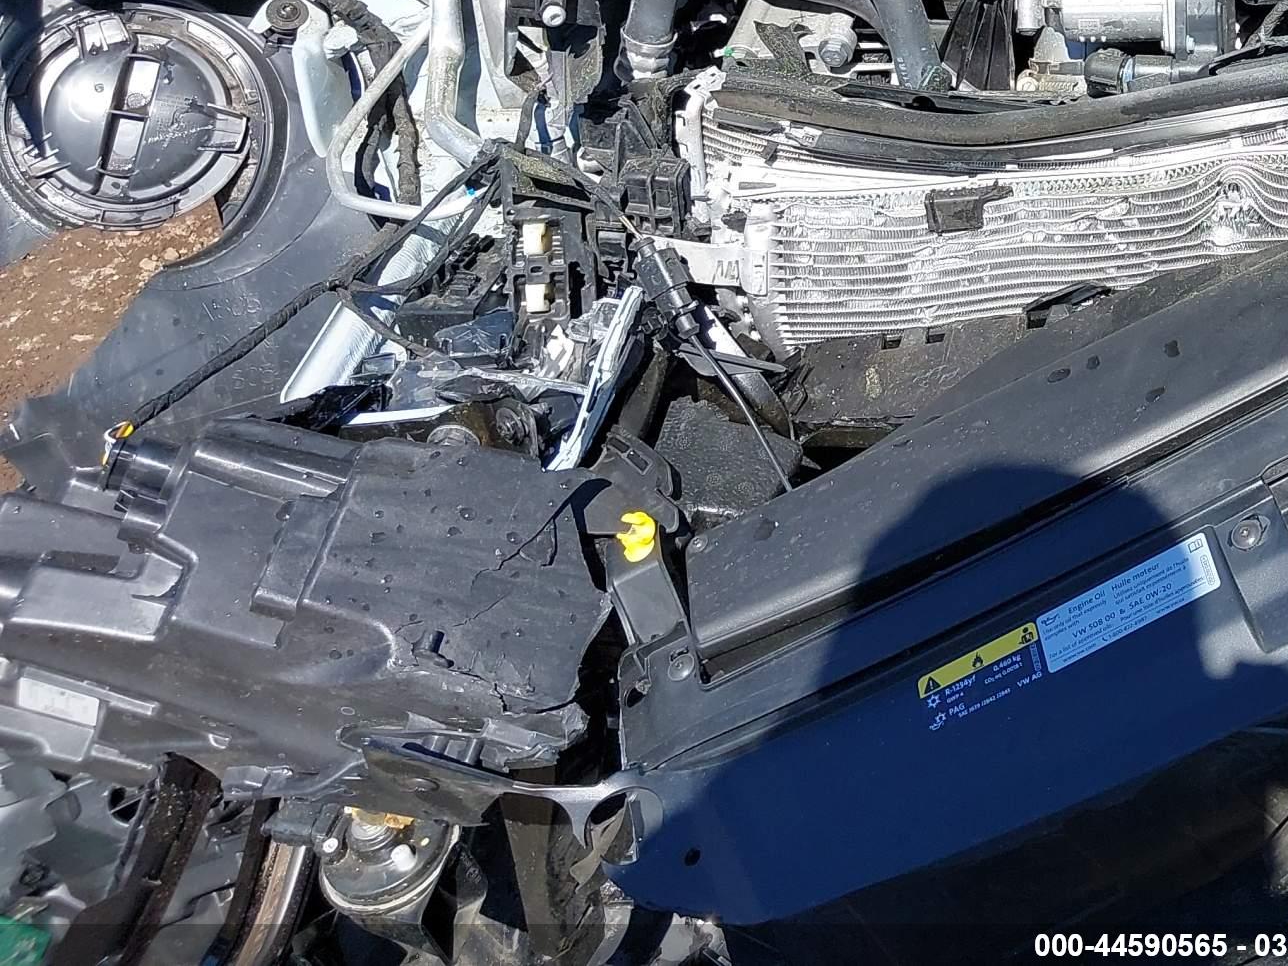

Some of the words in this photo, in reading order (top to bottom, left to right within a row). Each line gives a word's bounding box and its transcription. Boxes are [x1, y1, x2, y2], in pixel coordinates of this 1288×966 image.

[1131, 561, 1160, 581] moteur
[1067, 595, 1094, 616] Engine
[1093, 589, 1106, 601] Oil
[1071, 625, 1087, 639] VW
[1087, 617, 1103, 631] 508
[1103, 610, 1116, 622] 00
[1127, 596, 1144, 610] SAE
[1144, 581, 1172, 601] 0W-20
[944, 674, 976, 697] R-1234yf
[1016, 676, 1030, 688] VW
[1030, 670, 1042, 681] AG
[948, 701, 965, 716] PAG
